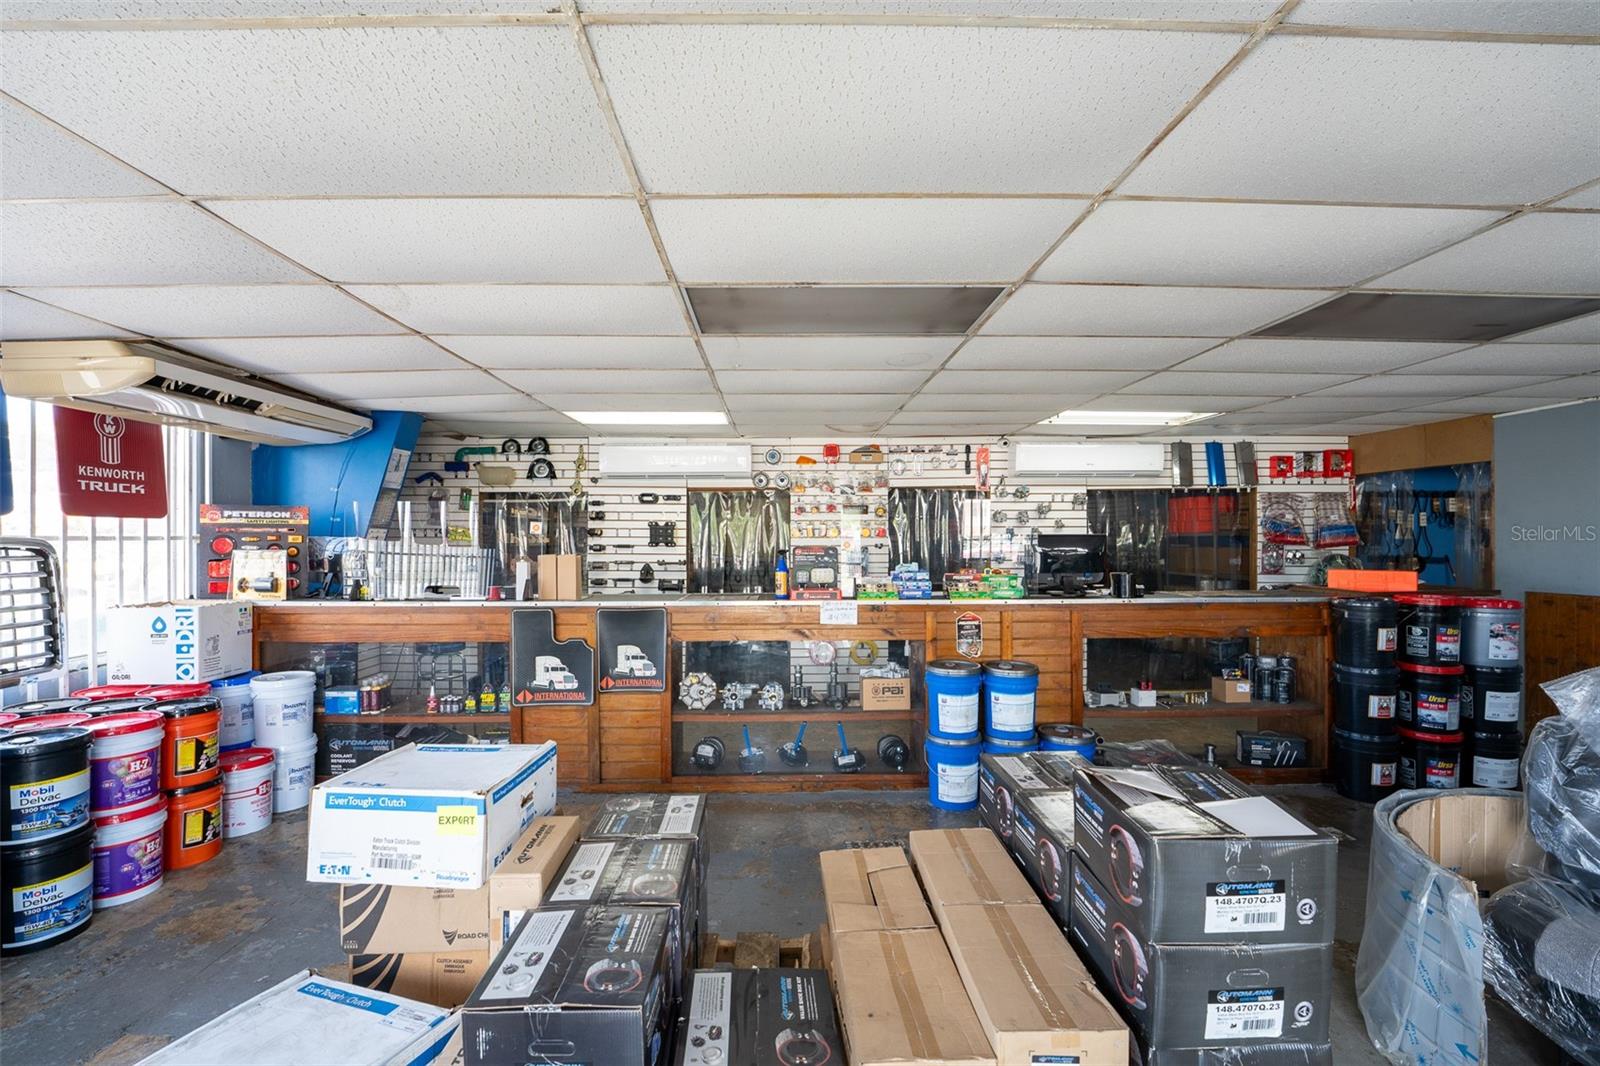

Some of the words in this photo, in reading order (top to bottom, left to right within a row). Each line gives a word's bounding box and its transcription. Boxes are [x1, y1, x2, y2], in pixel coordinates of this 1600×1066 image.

[78, 465, 145, 481] KENWORTH
[77, 479, 145, 495] TRUCK
[223, 510, 291, 519] PETERSON
[615, 678, 663, 687] INTERNATIONAL
[534, 691, 586, 701] INTERNATIONAL
[1428, 695, 1446, 703] Ursa
[328, 738, 389, 751] AUTOMANN
[19, 785, 55, 798] Mobil
[20, 793, 61, 807] Delvac
[329, 795, 376, 808] EverTough
[379, 796, 407, 808] Clutch
[21, 806, 38, 815] 1300
[40, 802, 60, 811] Super
[21, 820, 49, 830] 15W-40
[438, 816, 475, 825] EXPORT
[513, 824, 549, 865] AUTOMANN
[22, 885, 57, 900] Mobil
[1216, 882, 1275, 896] AUTOMANN
[22, 892, 64, 909] Delvac
[1214, 895, 1282, 906] 148.4707Q.23
[24, 907, 41, 916] 1300
[43, 901, 64, 912] Super
[23, 919, 52, 931] 15W-40
[457, 932, 476, 940] ROAD
[304, 984, 345, 1001] EverTough
[346, 996, 372, 1008] Clutch
[1217, 989, 1274, 1003] AUTOMANN
[1215, 1003, 1281, 1013] 148.4707Q.23
